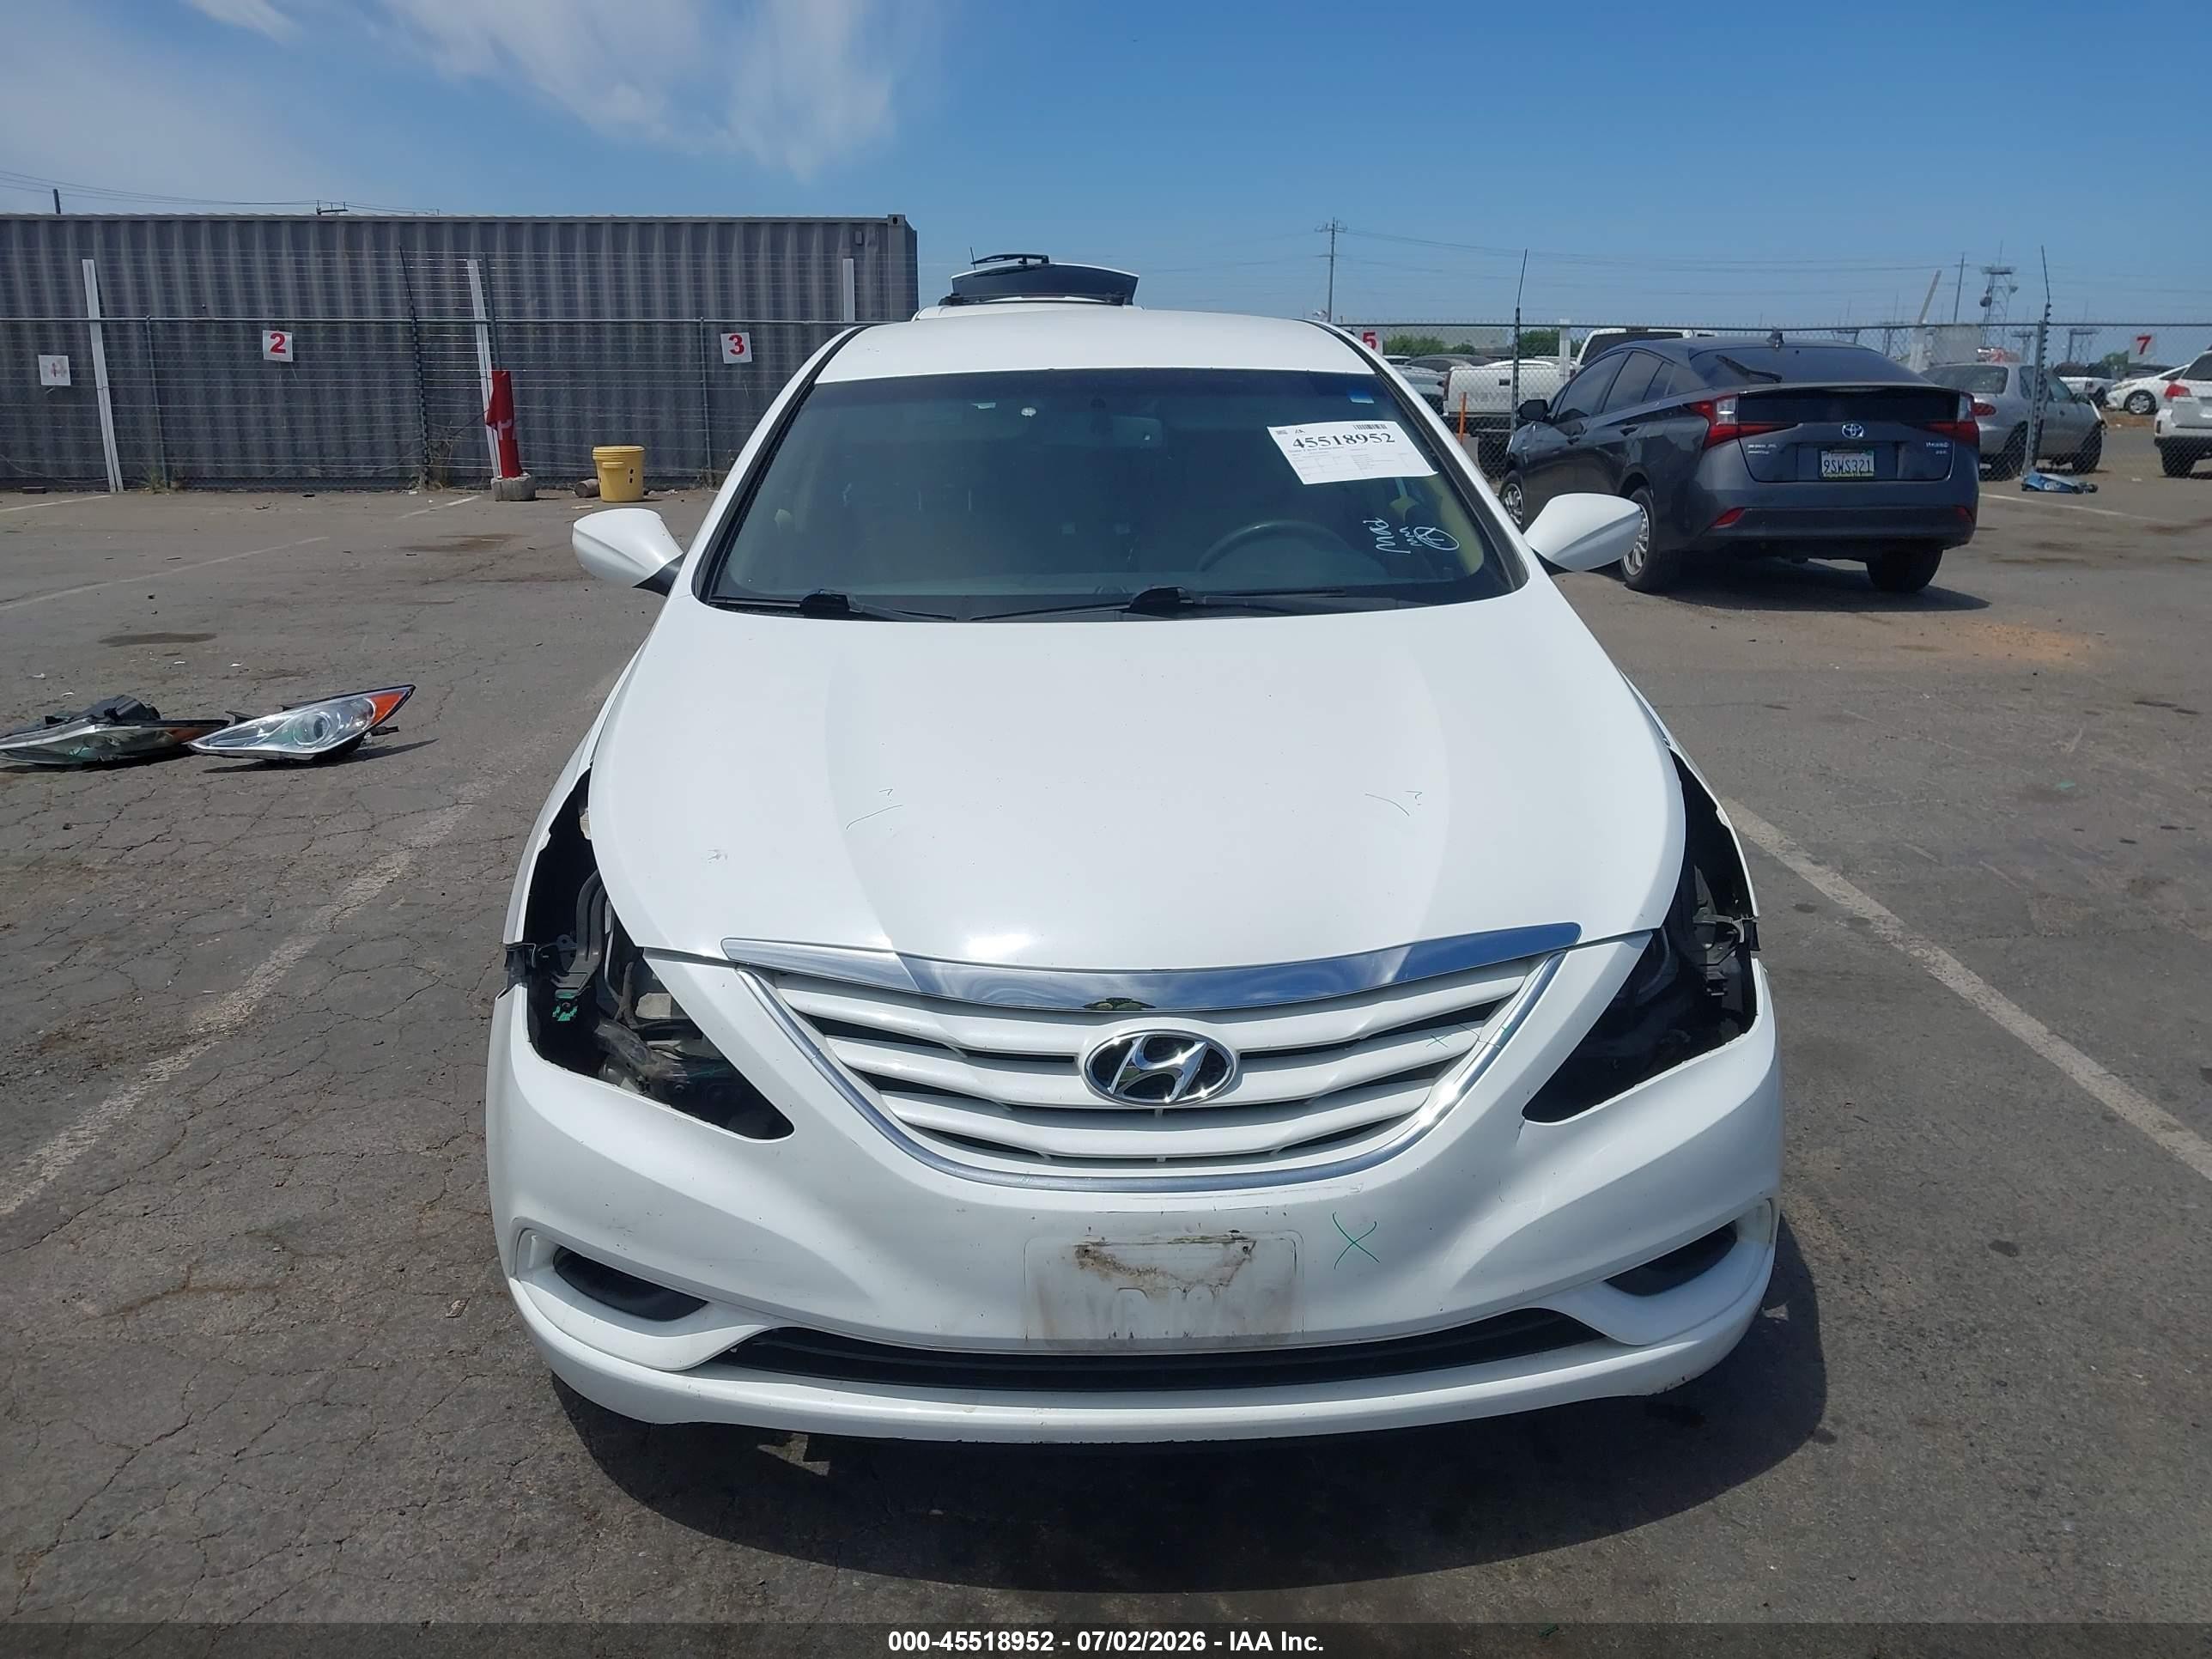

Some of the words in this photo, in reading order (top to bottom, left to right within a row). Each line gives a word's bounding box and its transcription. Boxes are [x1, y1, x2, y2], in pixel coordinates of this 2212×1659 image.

[270, 332, 286, 354] 2
[728, 334, 744, 356] 3
[1362, 331, 1377, 350] 5
[2136, 335, 2152, 355] 7
[1292, 432, 1395, 448] 45518952
[1823, 459, 1870, 473] 9SWS321
